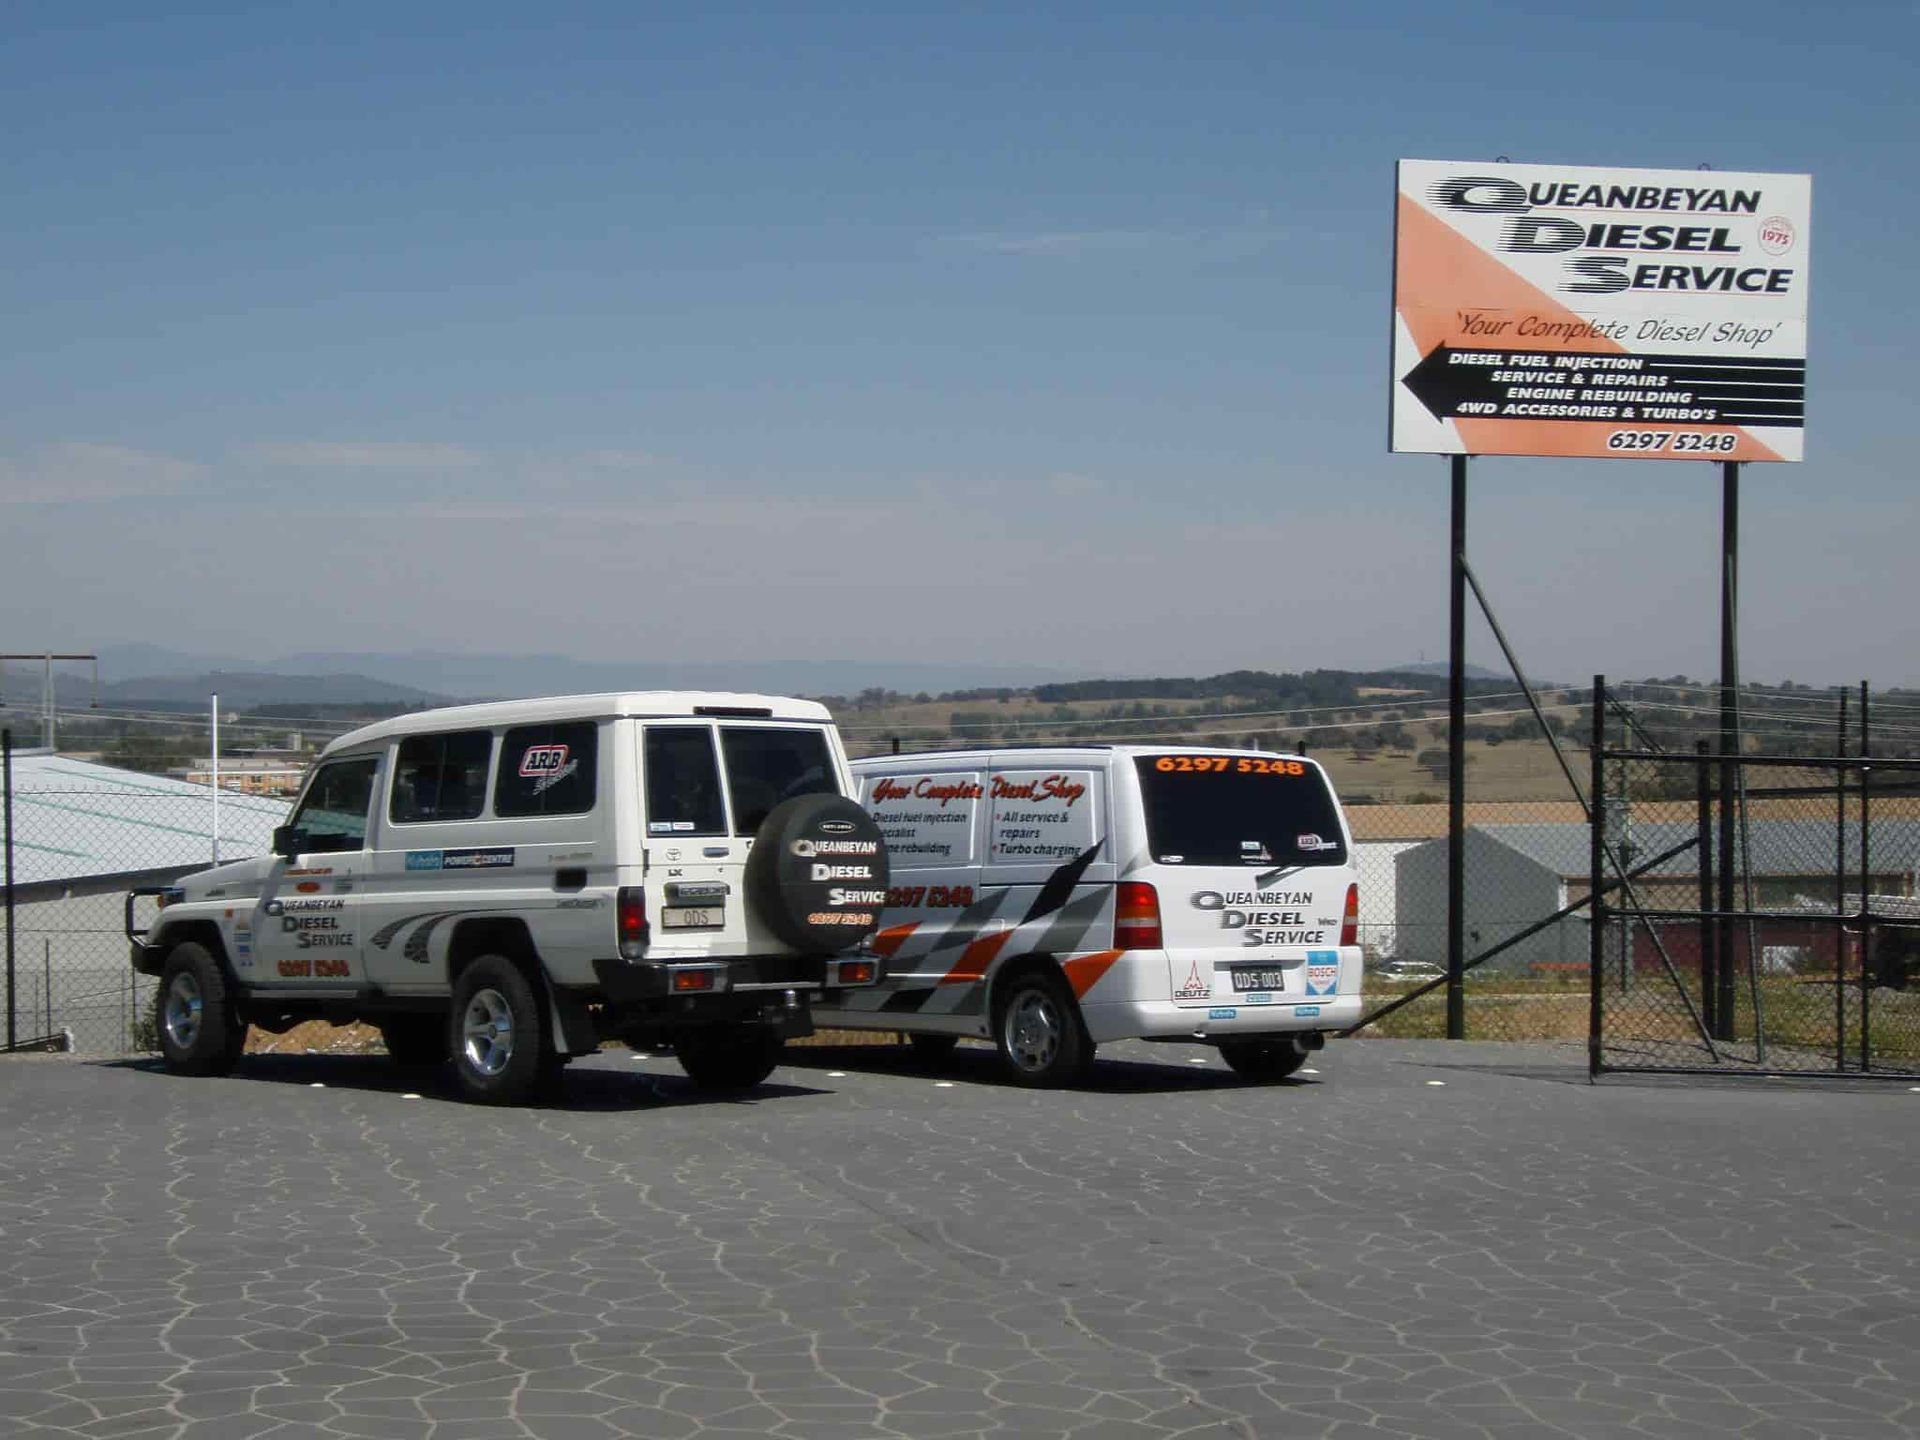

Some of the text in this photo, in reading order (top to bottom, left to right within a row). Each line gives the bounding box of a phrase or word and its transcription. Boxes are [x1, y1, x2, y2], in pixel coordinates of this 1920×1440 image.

[1427, 176, 1762, 214] QUEANBEYAN
[1498, 216, 1741, 254] DIESEL
[1762, 229, 1789, 245] 1975
[1558, 256, 1793, 293] SERVICE
[1517, 316, 1629, 344] Complete
[1636, 319, 1711, 343] Diesel
[1448, 352, 1643, 370] DIESEL FUEL INJECTION
[1491, 371, 1669, 387] SERVICE & REPAIRS
[1506, 387, 1692, 404] ENGINE REBUILDING
[1456, 402, 1718, 420] 4WD ACCESSORIES & TURBO'S
[1608, 431, 1737, 452] 6297 5248
[525, 751, 562, 770] ARB
[1155, 757, 1304, 775] 6297 5248
[914, 778, 984, 808] Complete
[1031, 775, 1086, 807] Shop
[873, 812, 902, 823] Diesel
[923, 813, 967, 825] injection
[1003, 811, 1070, 823] All service &
[1000, 829, 1040, 842] repairs
[790, 839, 877, 857] QUEANBEYAN
[1000, 843, 1082, 858] Turbo charging
[811, 863, 872, 881] DIESEL
[829, 888, 886, 906] SERVICE
[1191, 891, 1313, 910] QUEANBEYAN
[264, 900, 345, 917] QUEANBEYAN
[282, 916, 340, 933] DIESEL
[1220, 910, 1306, 929] DIESEL
[297, 932, 354, 949] SERVICE
[1243, 929, 1325, 947] SERVICE
[1308, 966, 1336, 977] BOSCH
[1175, 989, 1211, 998] DEUTZ
